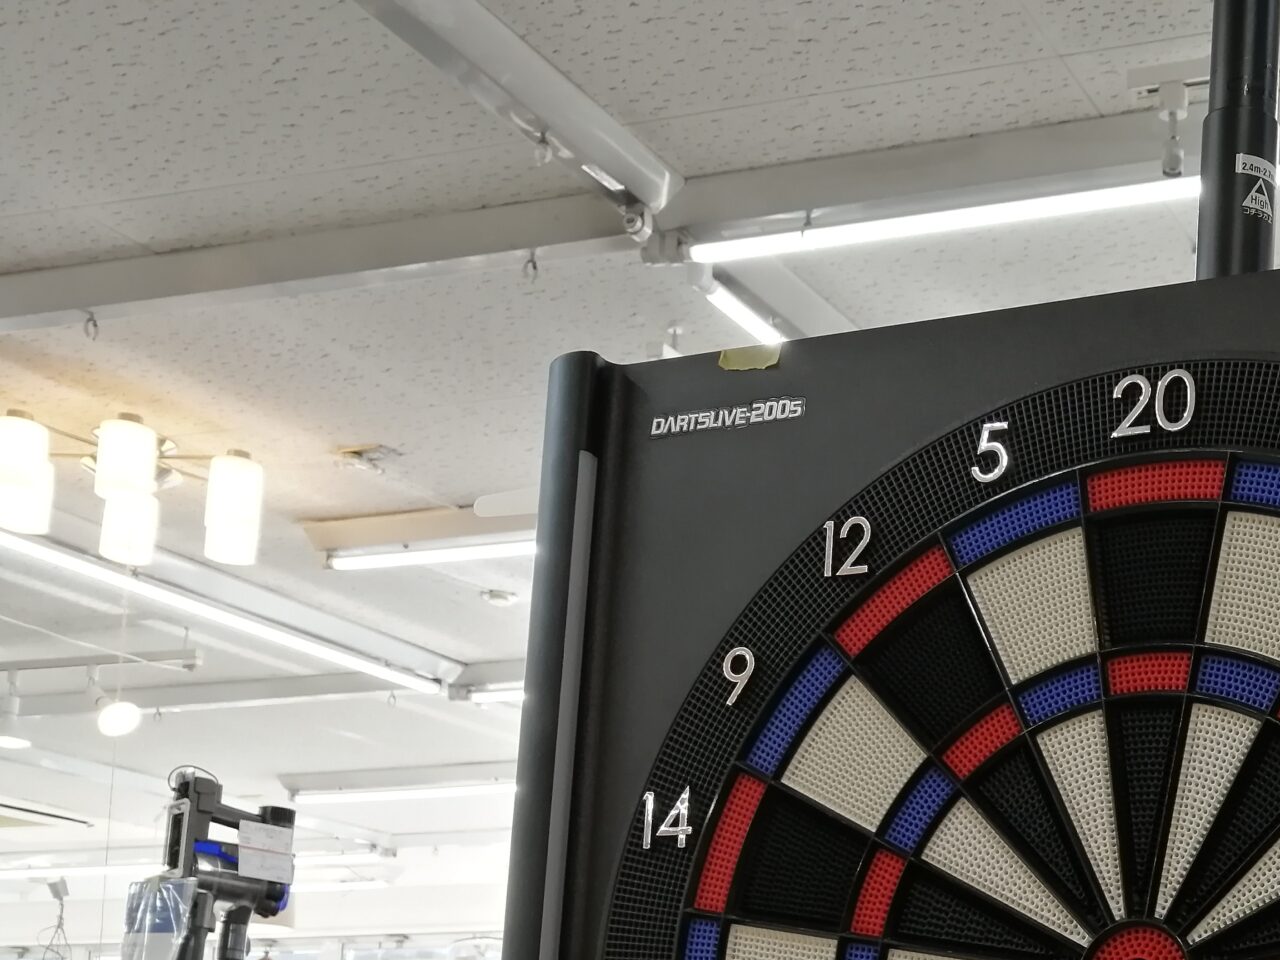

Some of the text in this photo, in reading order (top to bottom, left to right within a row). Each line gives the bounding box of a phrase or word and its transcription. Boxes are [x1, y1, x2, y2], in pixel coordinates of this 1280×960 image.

[1250, 195, 1269, 210] High
[1111, 368, 1197, 438] 20
[971, 421, 1009, 483] 5
[823, 516, 872, 577] 12
[722, 646, 755, 706] 9
[641, 785, 692, 849] 14
